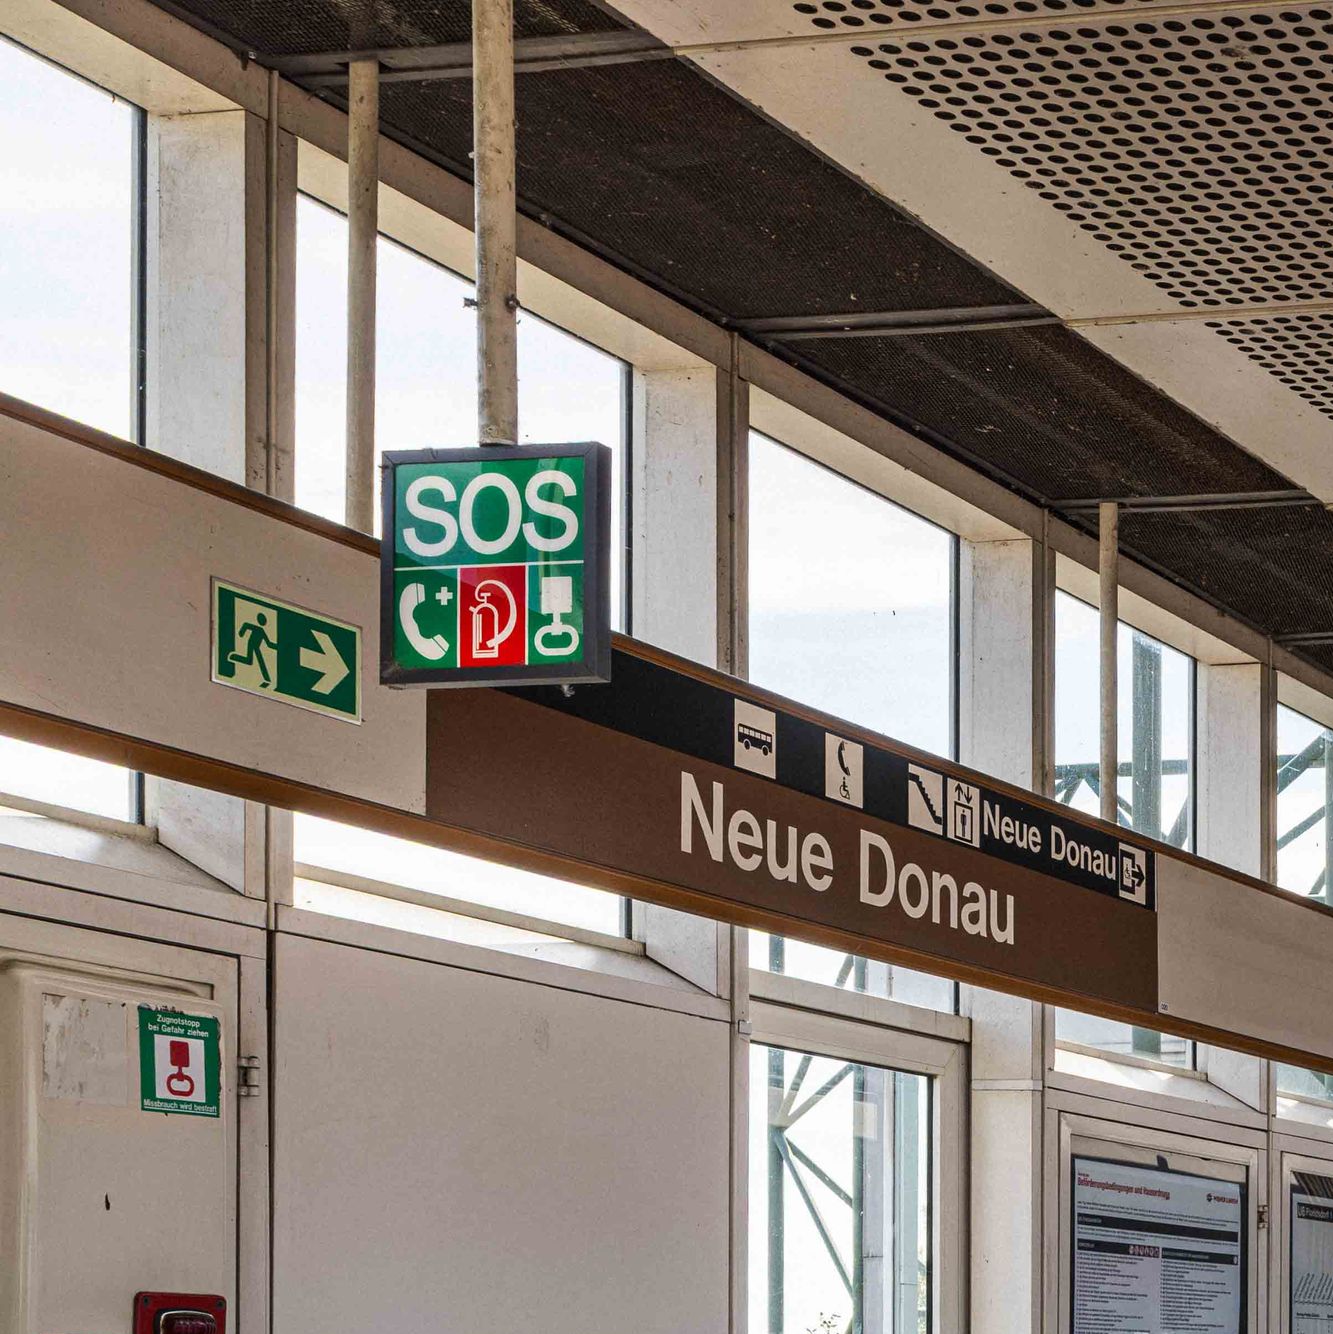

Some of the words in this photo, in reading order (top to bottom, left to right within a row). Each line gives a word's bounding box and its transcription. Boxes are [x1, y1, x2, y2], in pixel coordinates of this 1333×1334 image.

[403, 470, 579, 557] SOS
[680, 771, 834, 892] Neue
[859, 829, 1015, 945] Donau
[982, 799, 1042, 854] Neue
[1050, 825, 1116, 881] Donau
[148, 1022, 159, 1031] bei
[161, 1024, 185, 1034] Gefahr
[187, 1028, 209, 1037] ziehen
[157, 1014, 200, 1027] Zugnotstopp
[144, 1098, 178, 1109] Missbrauch
